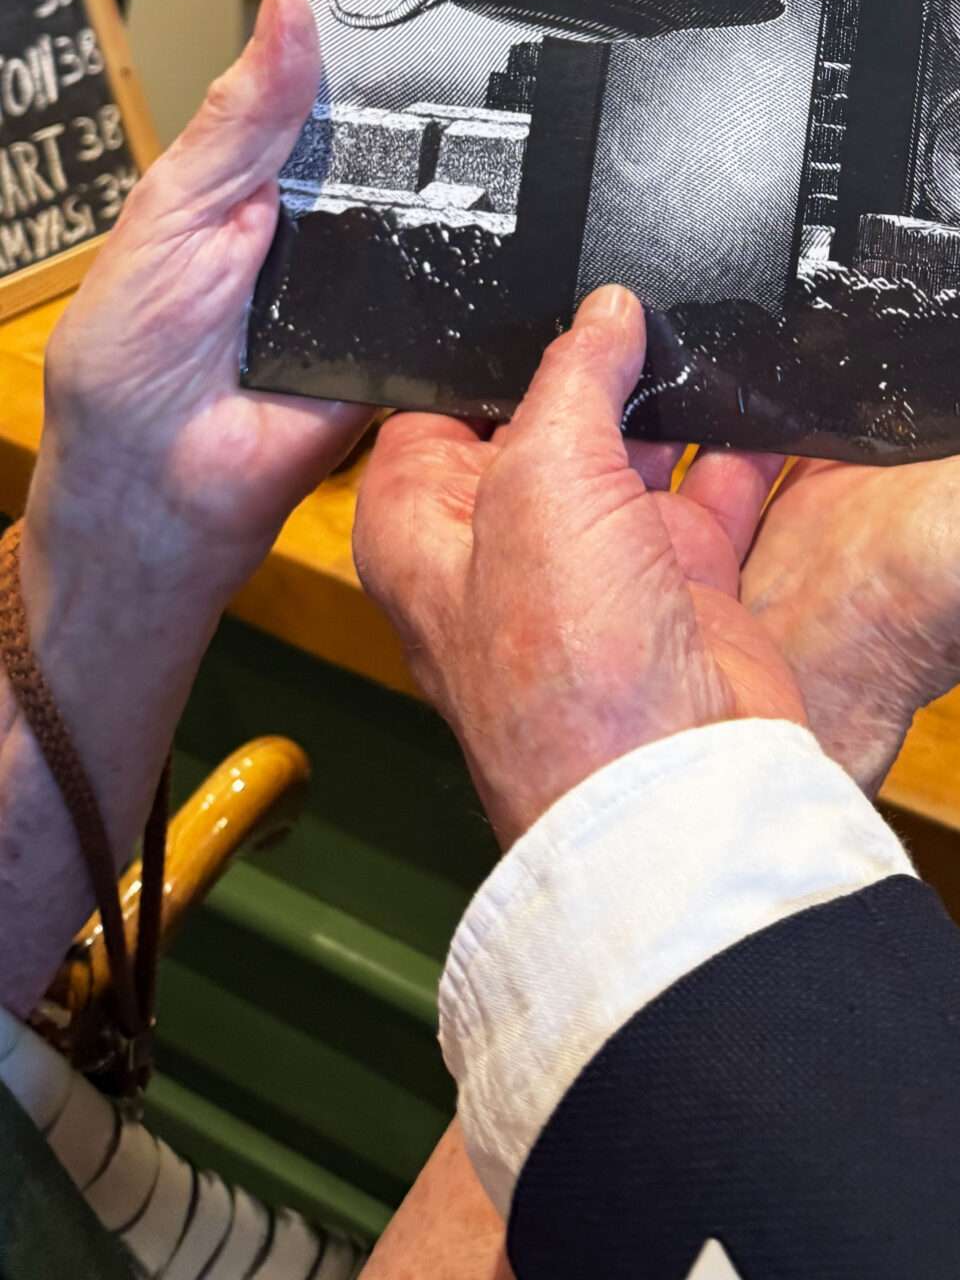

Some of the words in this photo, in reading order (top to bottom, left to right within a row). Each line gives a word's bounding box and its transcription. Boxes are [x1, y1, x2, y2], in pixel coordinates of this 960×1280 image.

[0, 32, 58, 117] ON
[54, 27, 105, 87] 38
[0, 122, 68, 218] ART
[71, 104, 124, 162] 38
